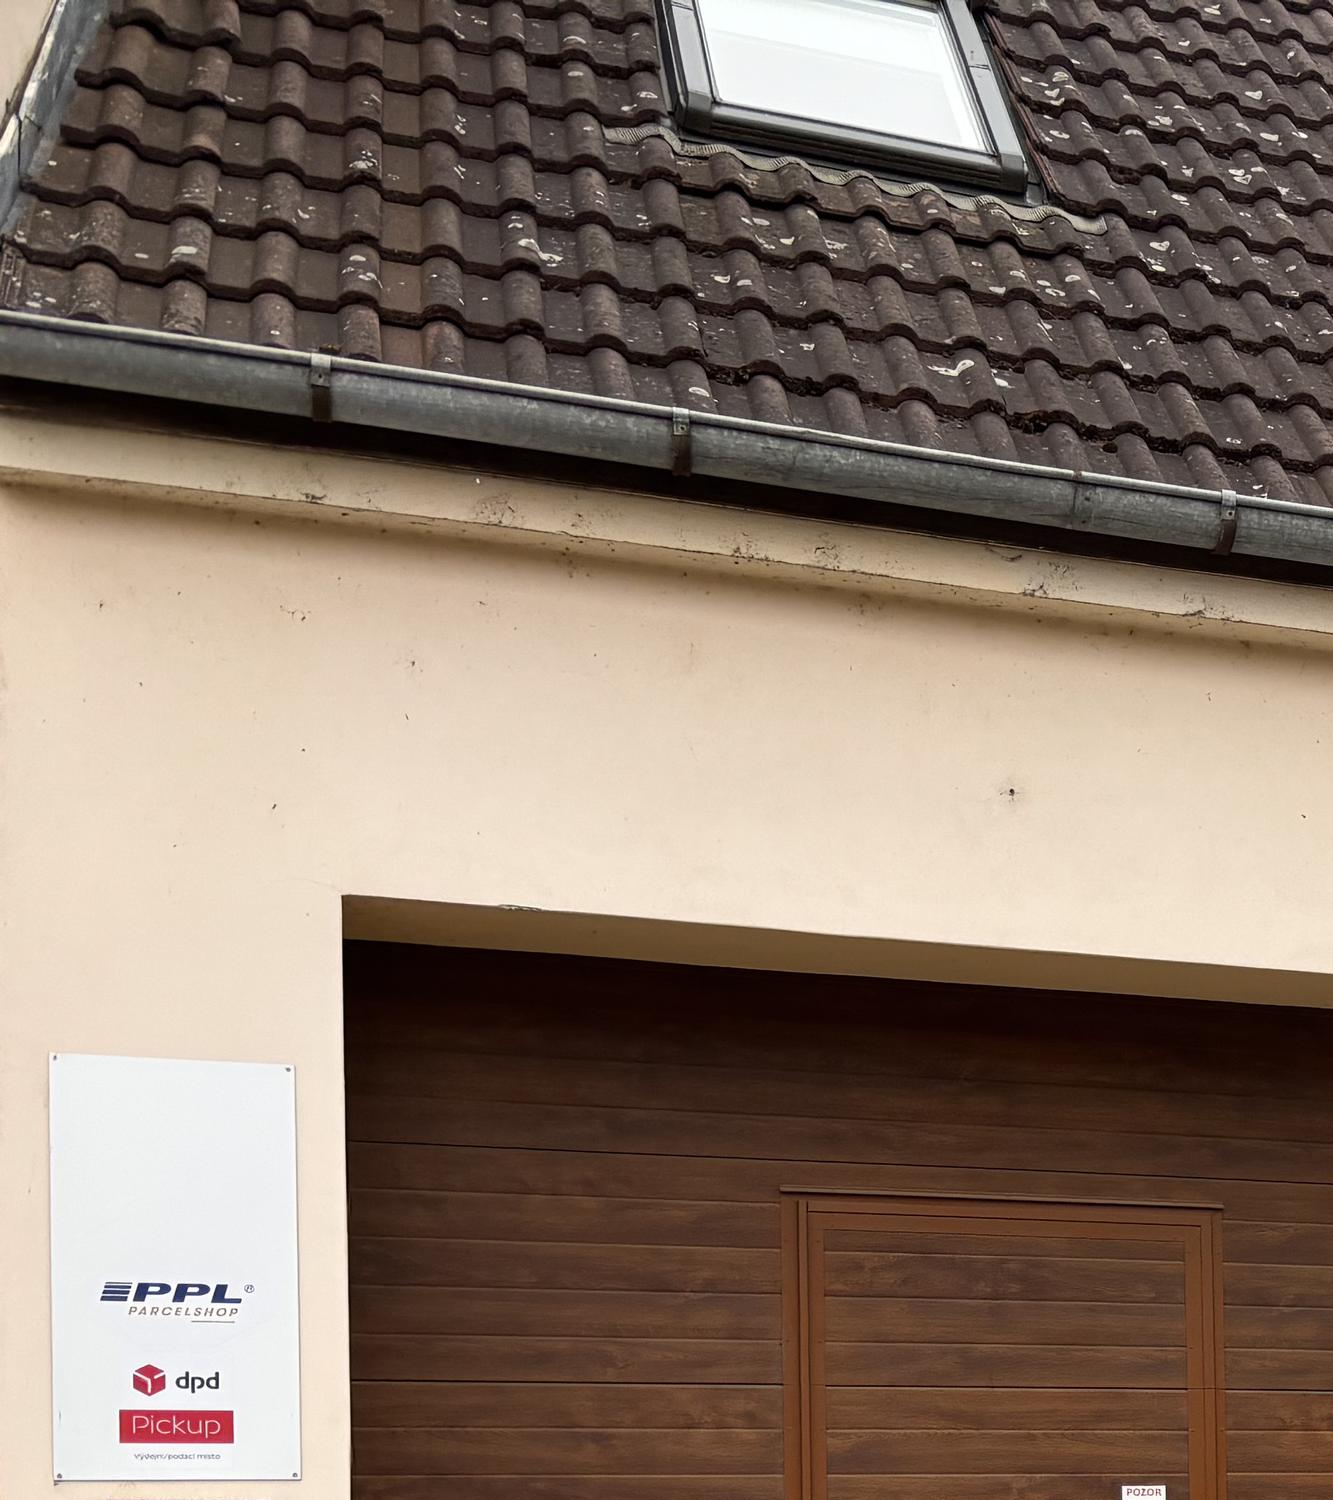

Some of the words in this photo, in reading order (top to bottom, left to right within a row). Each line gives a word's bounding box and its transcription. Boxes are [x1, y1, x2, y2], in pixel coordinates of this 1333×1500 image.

[132, 1282, 243, 1304] PPL
[127, 1306, 239, 1317] PARCELSHOP
[175, 1371, 220, 1393] dpd
[132, 1415, 221, 1439] Pickup
[1126, 1488, 1162, 1497] POZOR
